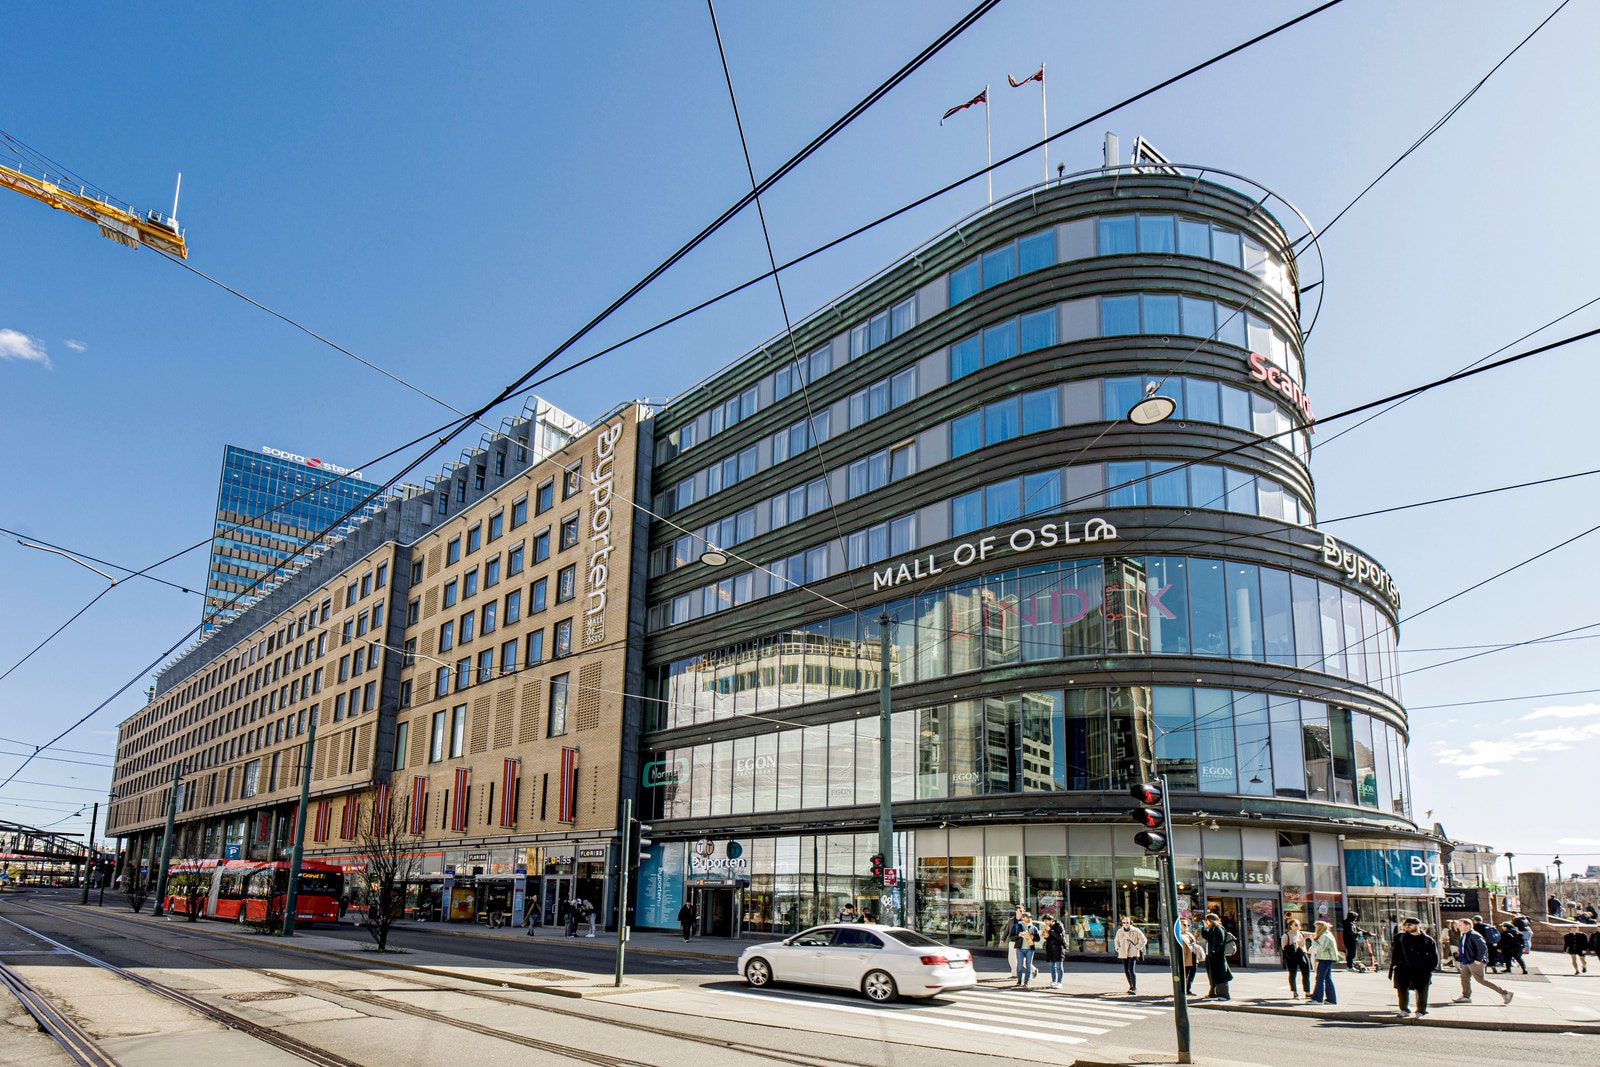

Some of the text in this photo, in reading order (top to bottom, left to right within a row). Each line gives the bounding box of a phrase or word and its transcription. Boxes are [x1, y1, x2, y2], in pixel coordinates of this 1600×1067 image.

[262, 445, 363, 479] sopra steria
[587, 422, 623, 616] Byporten
[873, 554, 943, 591] MALL
[953, 536, 996, 566] OF
[736, 754, 776, 772] EGON
[952, 771, 979, 782] EGON
[1202, 766, 1232, 776] EGON
[692, 857, 745, 870] Byporten
[1439, 896, 1465, 904] GON
